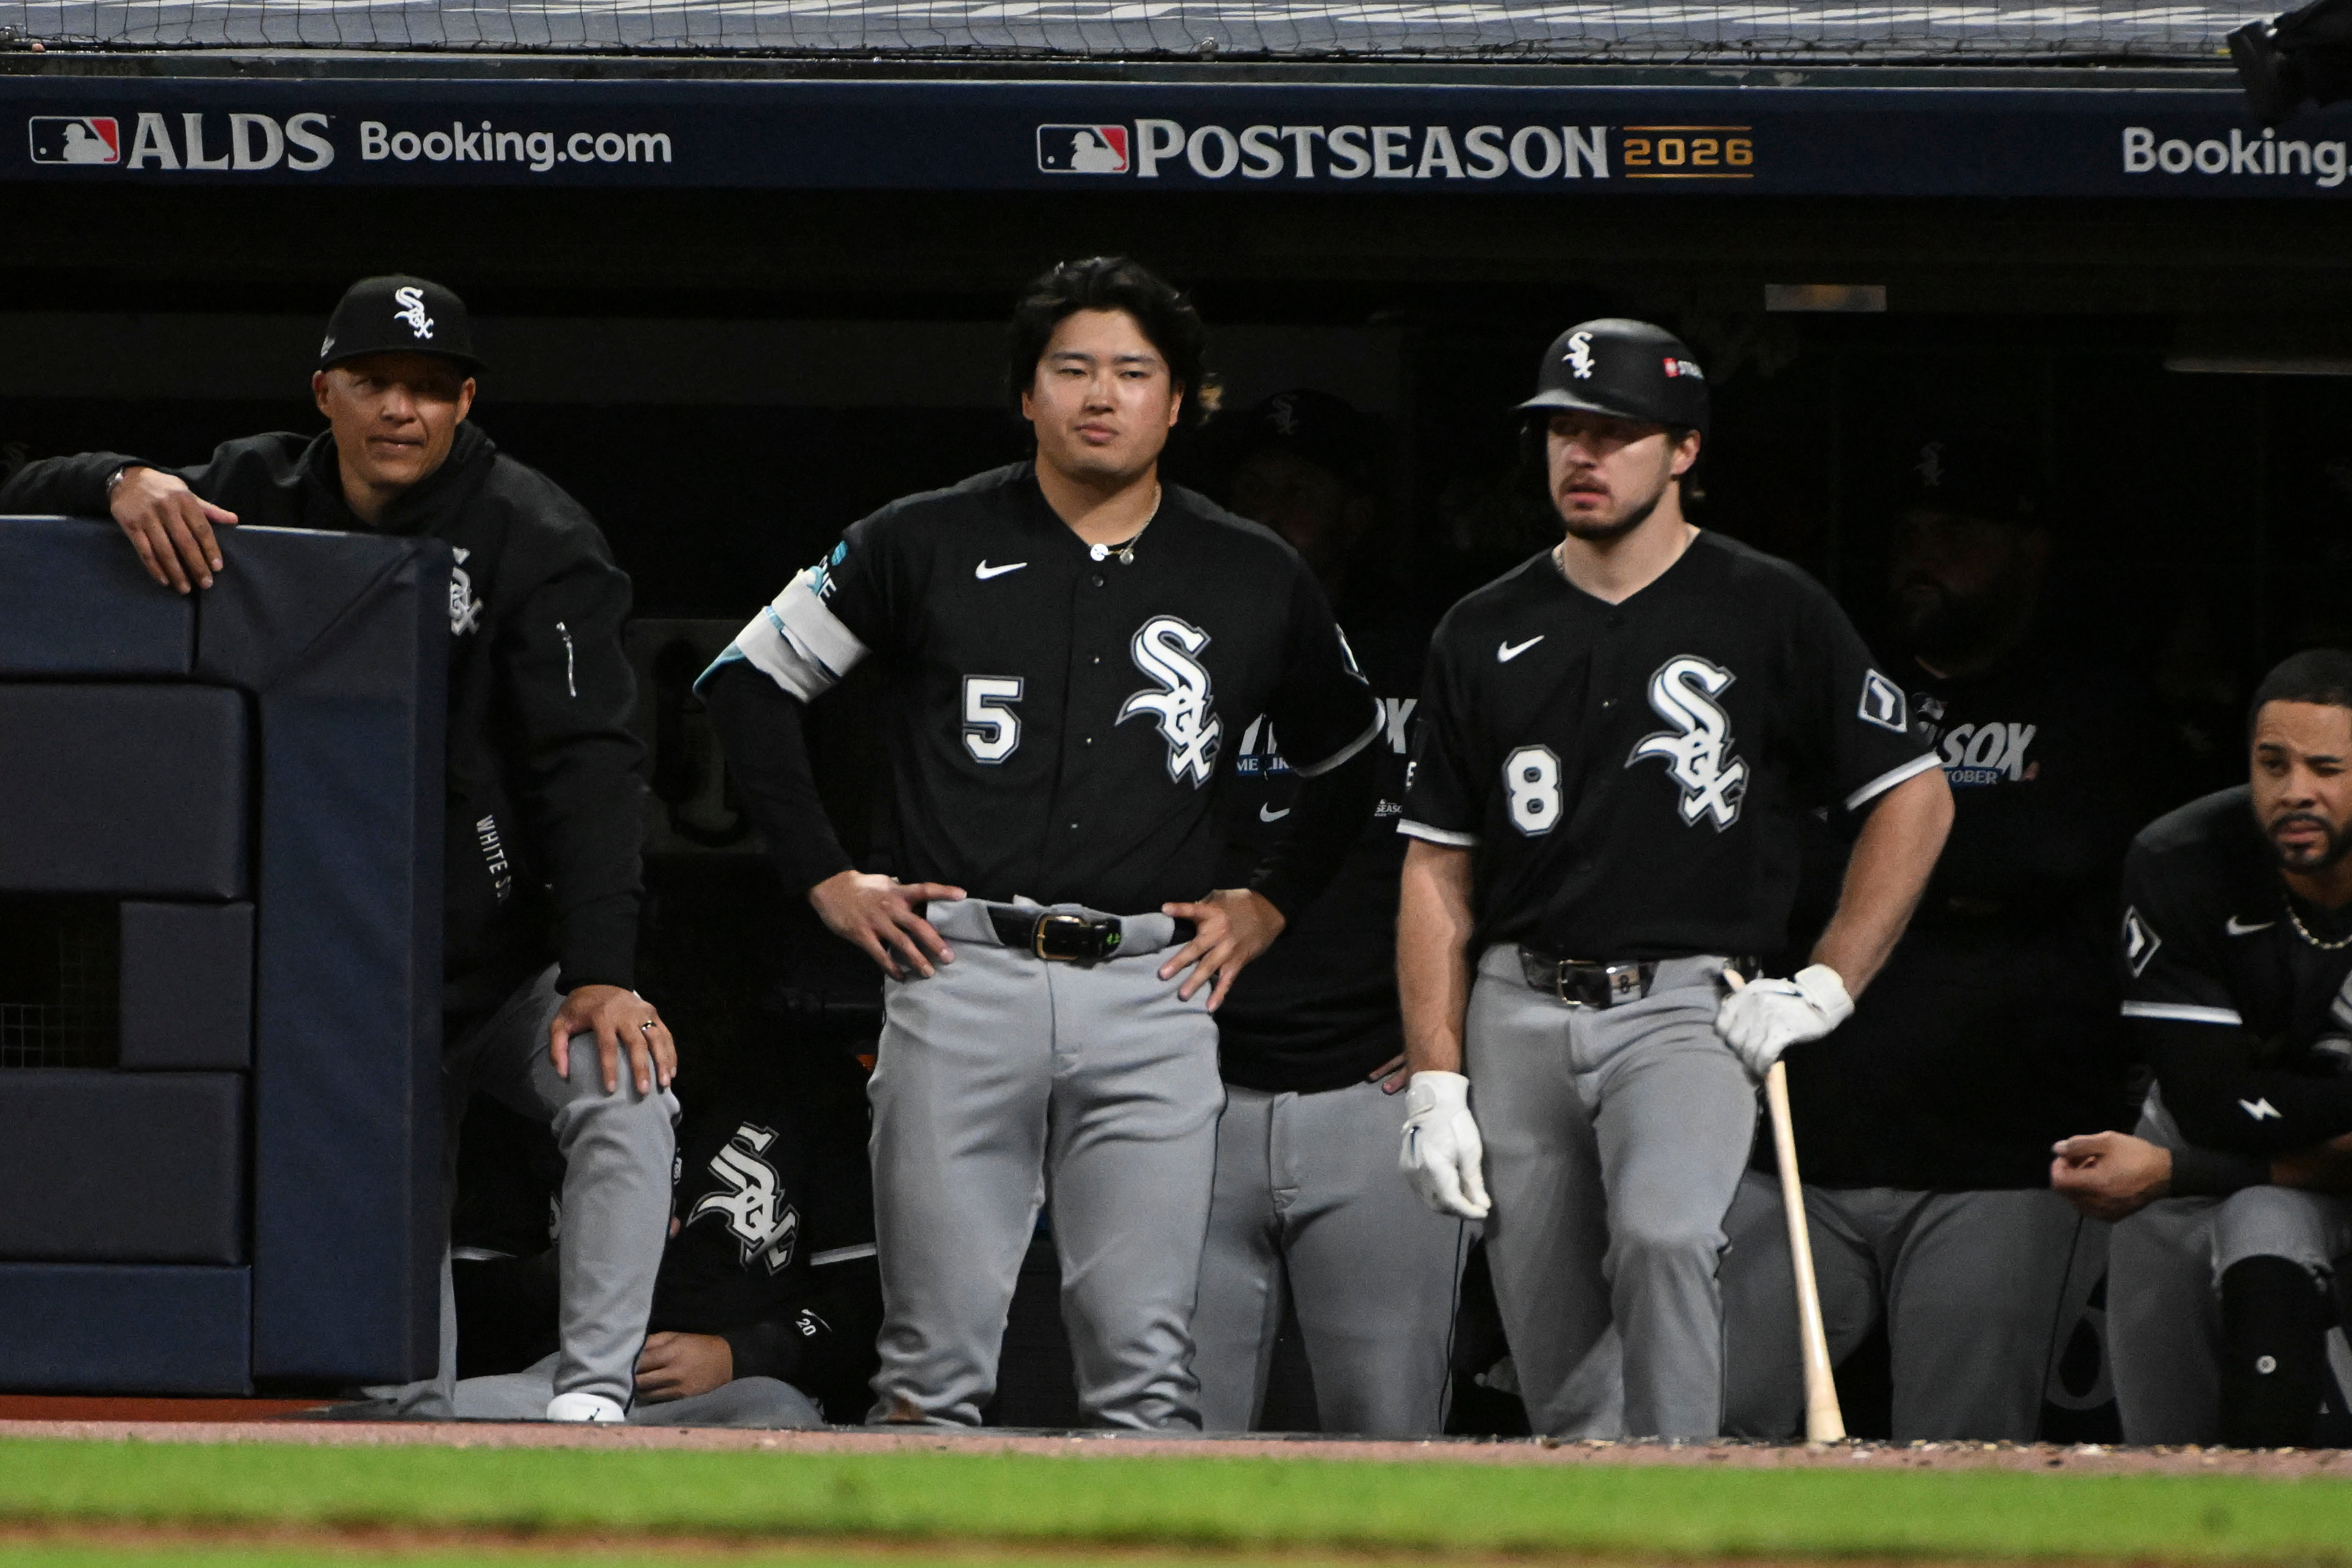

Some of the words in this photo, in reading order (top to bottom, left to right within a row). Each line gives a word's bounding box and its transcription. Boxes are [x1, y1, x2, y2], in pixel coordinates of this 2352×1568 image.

[126, 112, 335, 171] ALDS
[360, 120, 671, 172] Booking.com
[1134, 118, 1610, 179] POSTSEASON
[1623, 138, 1753, 166] 2026
[962, 674, 1024, 765] 5
[1236, 758, 1259, 771] ME
[1941, 722, 2037, 781] SOX
[1945, 770, 1999, 785] TOBER
[1376, 804, 1403, 814] SEASO
[1502, 744, 1564, 838] 8
[476, 814, 508, 874] WHITE
[795, 1318, 817, 1336] 20
